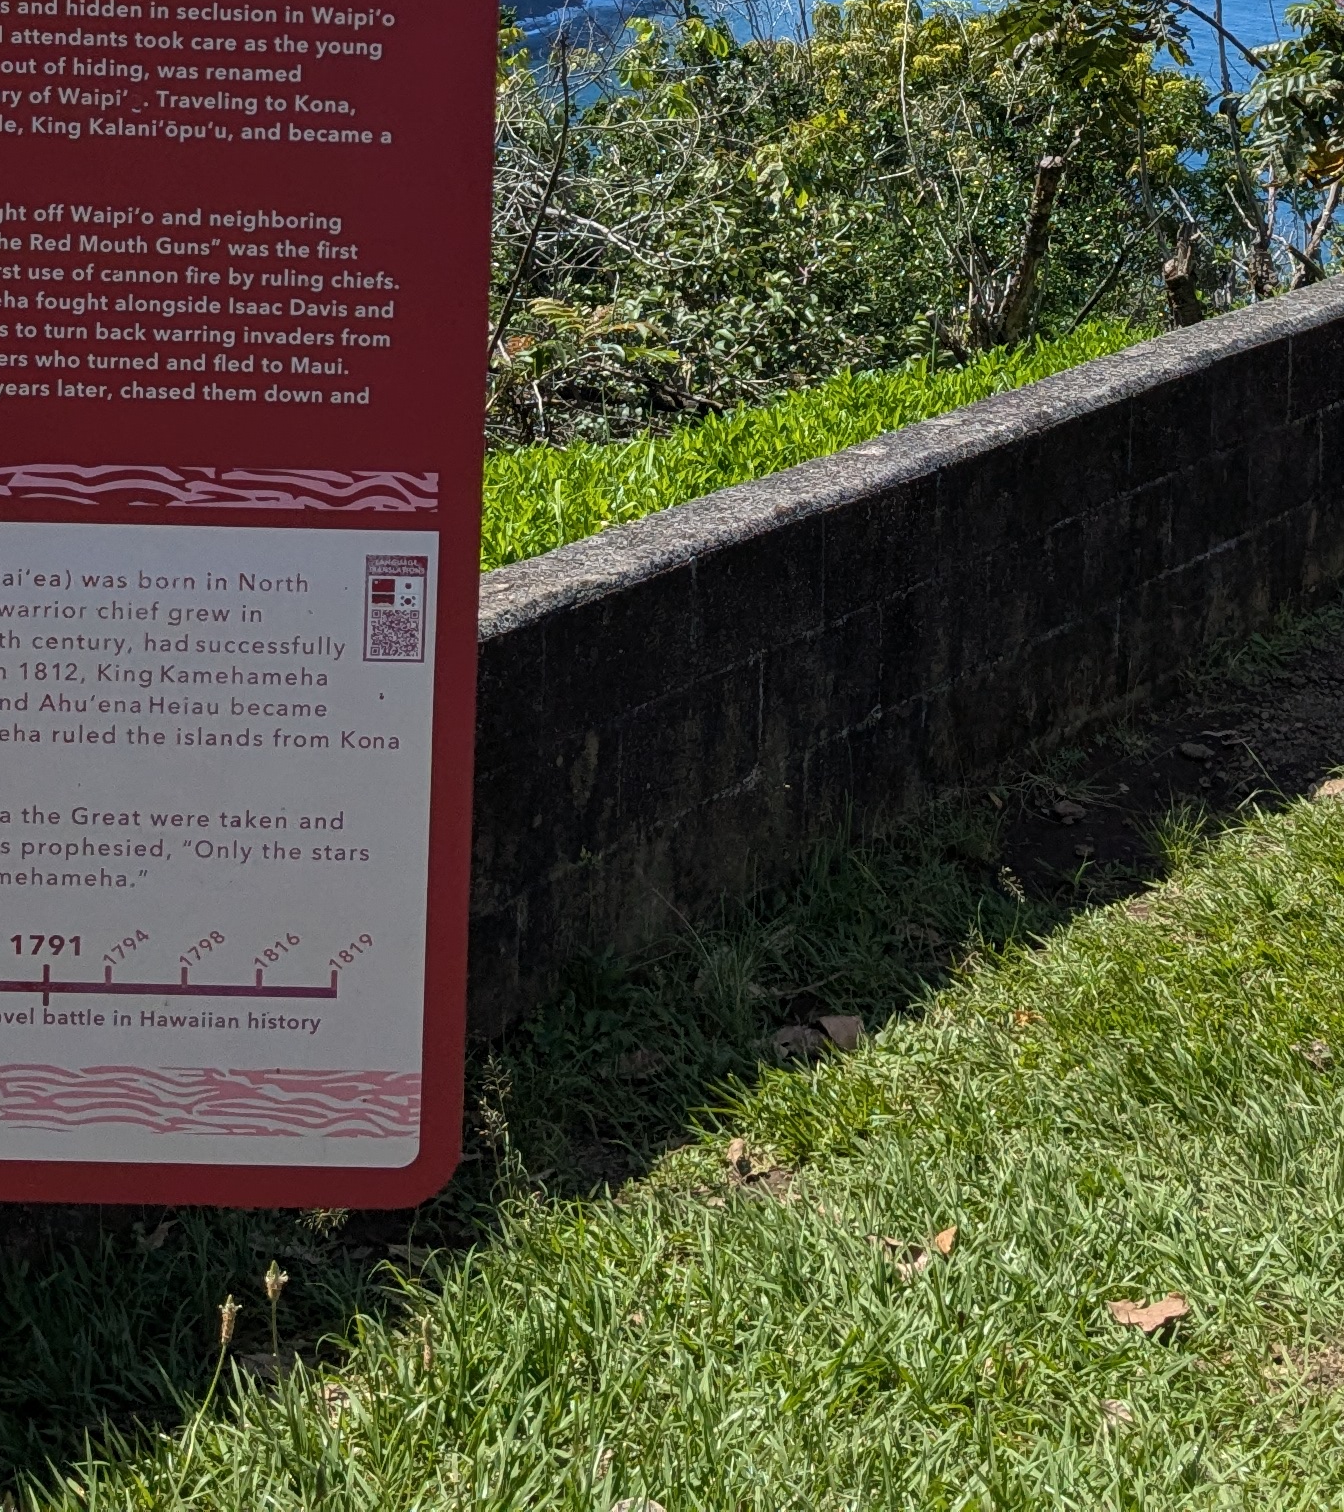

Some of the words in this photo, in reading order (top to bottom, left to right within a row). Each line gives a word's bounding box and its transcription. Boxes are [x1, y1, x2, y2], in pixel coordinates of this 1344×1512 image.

[11, 28, 127, 47] attendants
[135, 31, 184, 49] took
[191, 37, 237, 51] care
[245, 39, 267, 52] as
[274, 34, 308, 53] the
[316, 41, 382, 60] young
[29, 268, 64, 280] use
[72, 263, 94, 281] of
[101, 270, 178, 283] cannon
[186, 266, 221, 285] fire
[229, 267, 254, 290] by
[262, 269, 323, 292] ruling
[331, 270, 399, 289] chiefs.
[36, 291, 108, 314] fought
[115, 294, 221, 317] alongside
[229, 297, 282, 315] Isaac
[290, 299, 347, 317] Davis
[355, 301, 394, 318] and
[58, 379, 112, 400] later,
[120, 381, 195, 399] chased
[202, 383, 256, 401] them
[264, 384, 322, 403] down
[330, 387, 369, 404] and
[96, 601, 159, 620] chief
[168, 608, 230, 626] grew
[242, 605, 261, 622] in
[20, 662, 85, 684] 1812,
[98, 664, 152, 688] King
[161, 665, 327, 686] Kamehameha
[53, 725, 115, 744] ruled
[127, 726, 165, 745] the
[177, 727, 262, 746] islands
[273, 728, 329, 748] from
[342, 731, 399, 749] Kona
[21, 805, 60, 824] the
[72, 807, 140, 826] Great
[151, 814, 209, 827] were
[220, 808, 286, 829] taken
[300, 811, 343, 830] and
[10, 934, 81, 956] 1791
[103, 929, 149, 965] 1794
[179, 930, 225, 966] 1798
[254, 933, 300, 968] 1816
[329, 934, 373, 970] 1819
[44, 1008, 105, 1026] battle
[114, 1010, 131, 1026] in
[141, 1011, 239, 1028] Hawaiian
[248, 1012, 321, 1035] history
